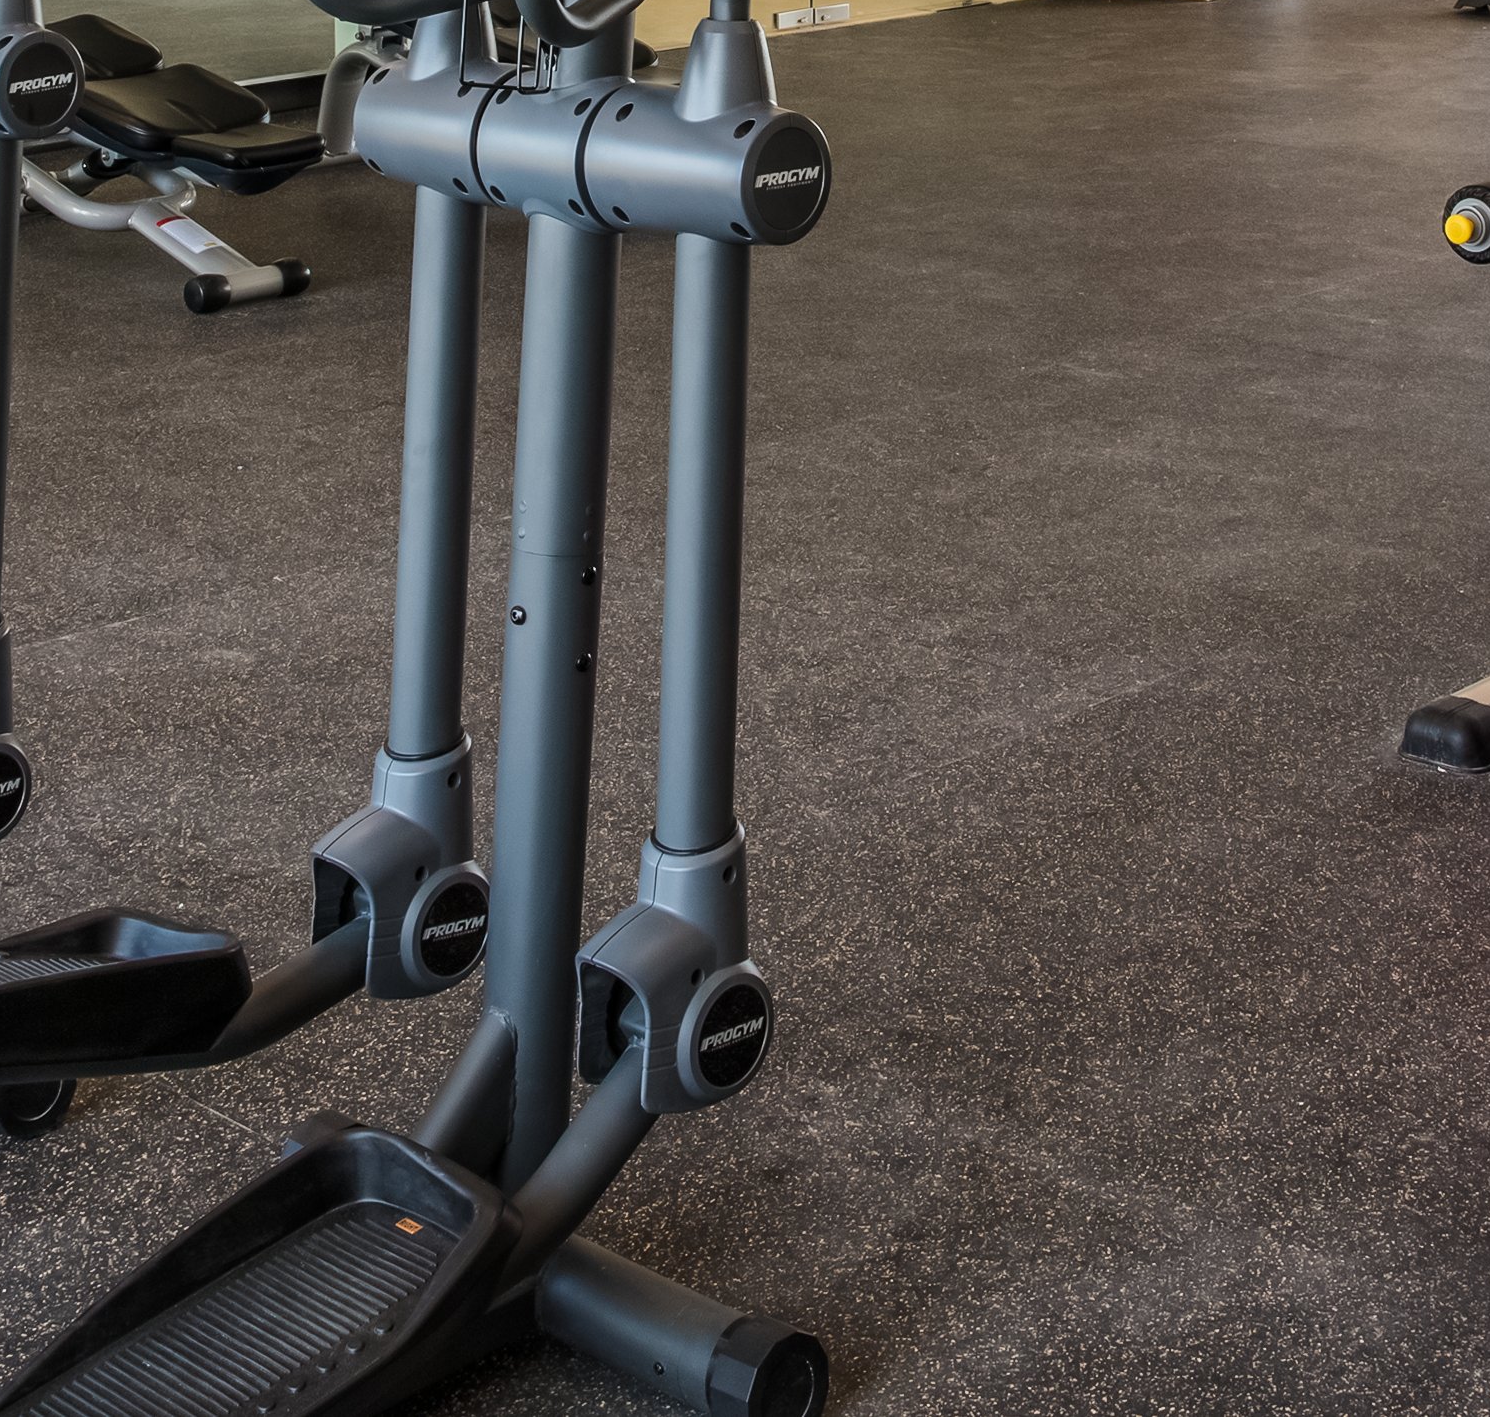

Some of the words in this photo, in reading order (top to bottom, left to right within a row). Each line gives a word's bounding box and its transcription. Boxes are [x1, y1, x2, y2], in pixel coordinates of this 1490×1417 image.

[8, 72, 74, 94] PROGYM
[754, 165, 821, 189] PROGYM
[421, 914, 487, 941] PROGYM
[699, 1016, 765, 1052] PROGYM
